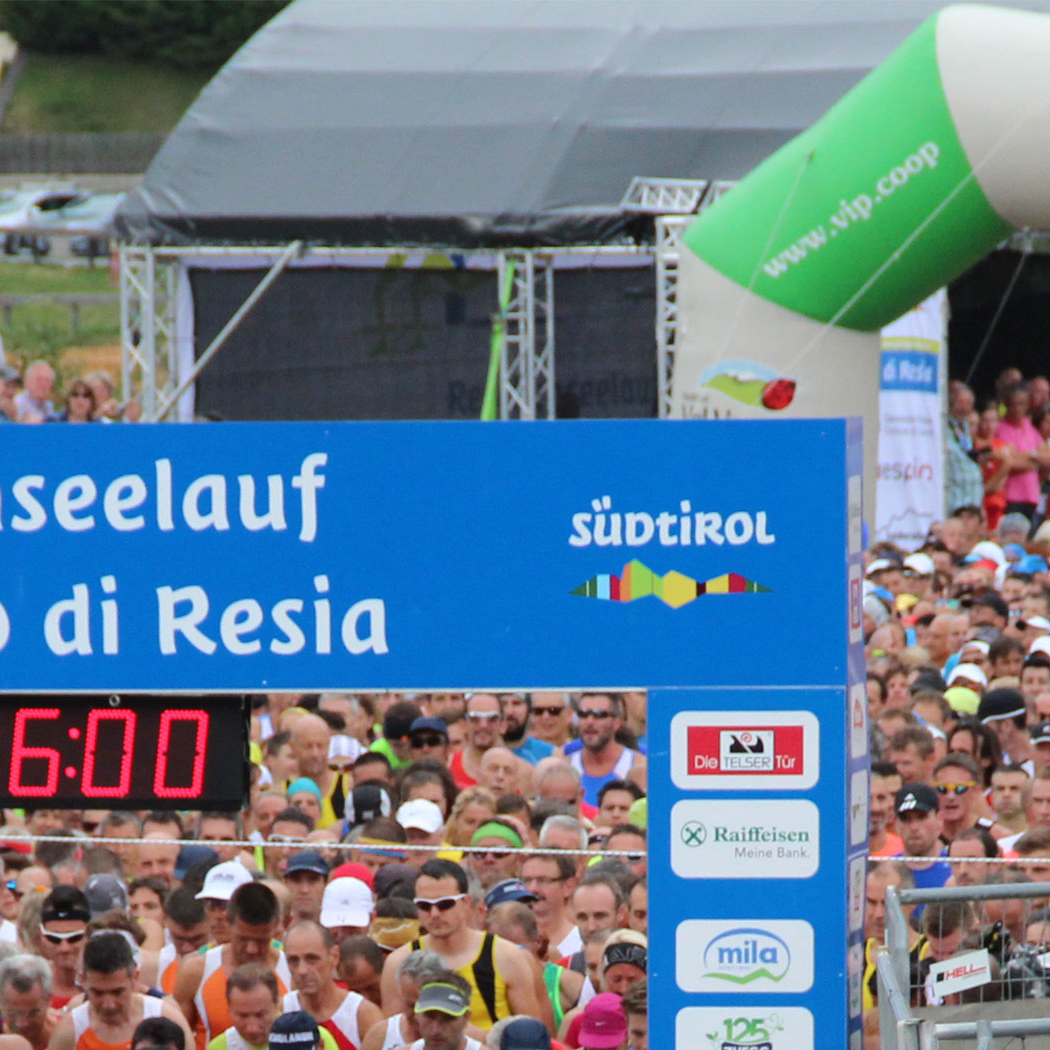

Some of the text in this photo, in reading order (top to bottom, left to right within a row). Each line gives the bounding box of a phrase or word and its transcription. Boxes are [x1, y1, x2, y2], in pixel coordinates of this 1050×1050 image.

[762, 141, 940, 279] www.vip.coop
[44, 575, 119, 656] di
[157, 575, 389, 656] Resia
[694, 753, 796, 770] Die TELSER Tür
[713, 826, 811, 842] Raiffeisen
[734, 847, 811, 860] Meine Bank.
[717, 940, 779, 965] mila
[945, 962, 988, 982] HELL
[723, 1017, 771, 1043] 125
